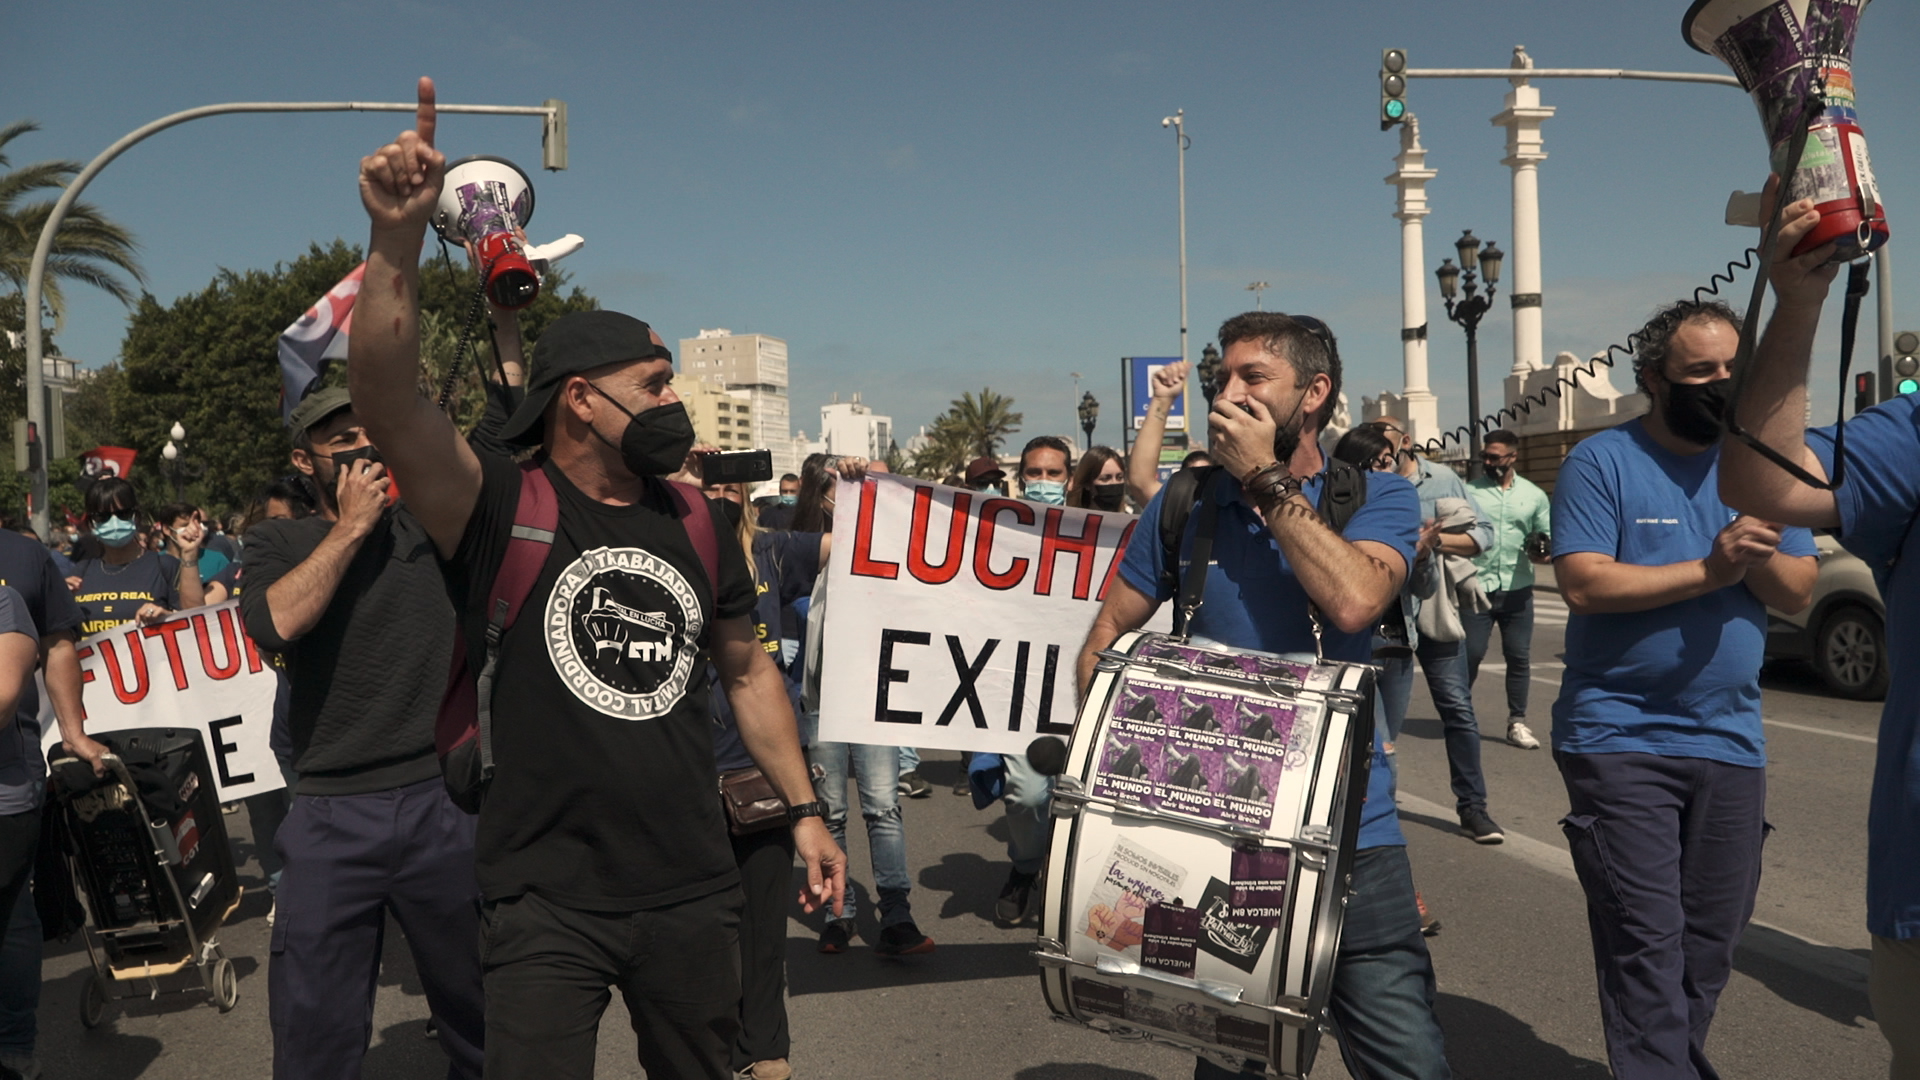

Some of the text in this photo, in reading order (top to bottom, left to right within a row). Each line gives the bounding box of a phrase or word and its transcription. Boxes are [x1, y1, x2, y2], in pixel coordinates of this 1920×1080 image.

[1778, 4, 1800, 41] HUELGA
[120, 590, 155, 601] REAL
[629, 610, 640, 619] EN
[641, 612, 666, 629] LUCHA
[550, 573, 626, 712] COORDINADORA
[1207, 668, 1246, 679] MUNDO
[1128, 679, 1162, 690] HUELGA
[1185, 688, 1219, 700] HUELGA
[1243, 697, 1278, 709] HUELGA
[1111, 720, 1166, 737] EL MUNDO
[1133, 733, 1155, 742] Brecha
[1168, 729, 1225, 746] EL MUNDO
[1175, 740, 1214, 751] Abrir Brecha
[1226, 738, 1284, 757] EL MUNDO
[1234, 750, 1273, 762] Abrir Brecha
[1095, 777, 1152, 795] EL MUNDO
[1102, 789, 1141, 801] Abrir Brecha
[1154, 787, 1211, 807] EL MUNDO
[1161, 800, 1200, 813] Abrir Brecha
[1213, 798, 1271, 818] EL MUNDO
[1220, 811, 1261, 825] Abrir Brecha
[1108, 860, 1125, 880] las
[1232, 907, 1281, 917] HUELGA 8M
[1144, 956, 1191, 969] HUELGA 8M
